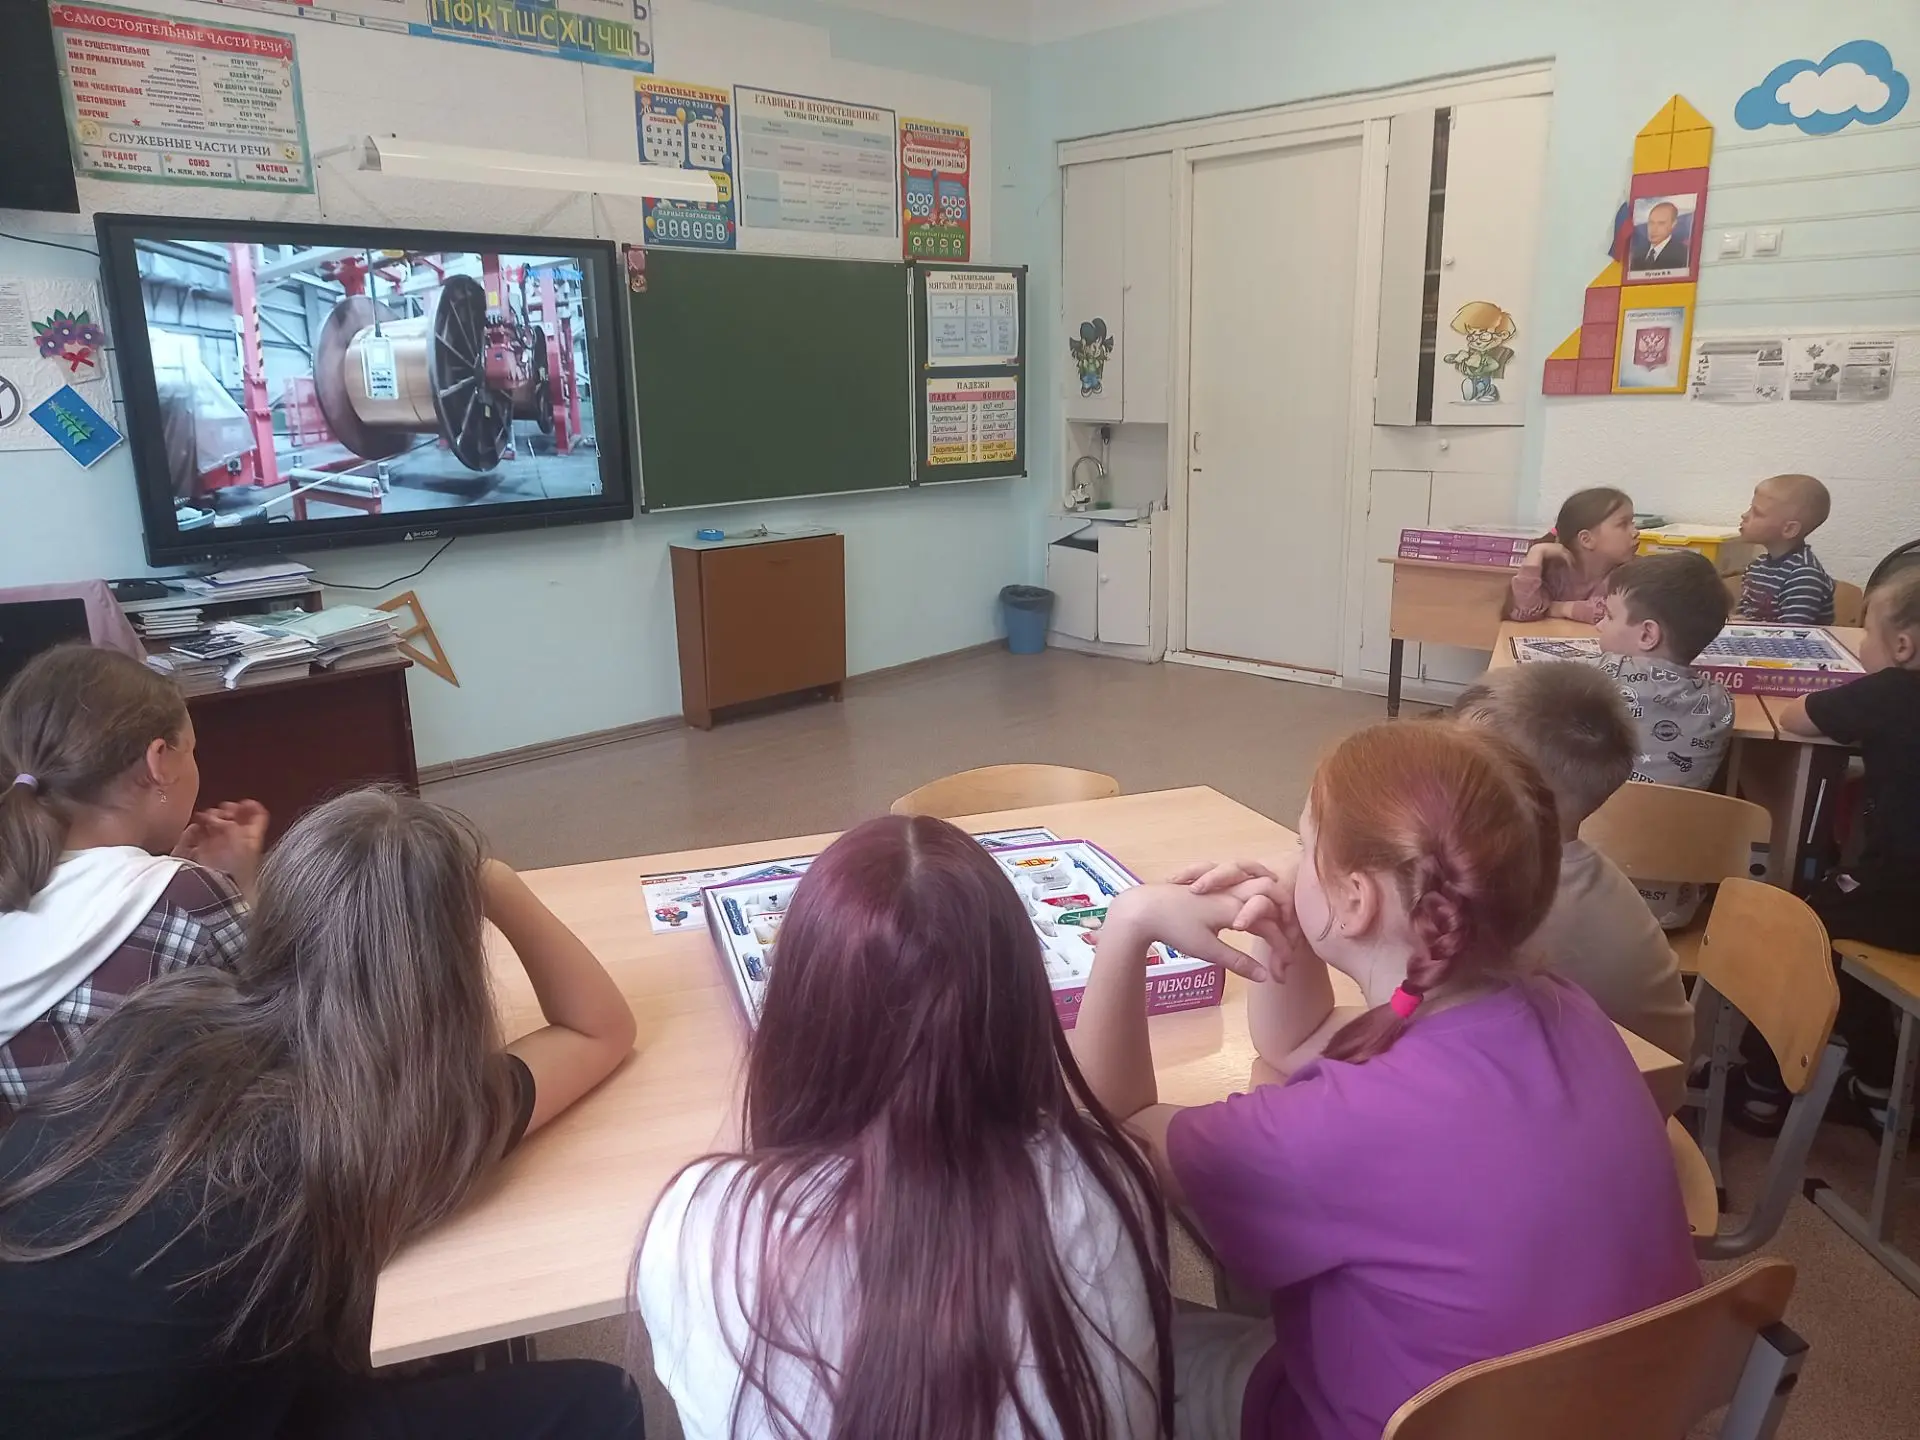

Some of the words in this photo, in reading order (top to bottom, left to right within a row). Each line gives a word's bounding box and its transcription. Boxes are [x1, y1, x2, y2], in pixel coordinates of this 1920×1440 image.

[63, 11, 205, 41] САМОСТОЯТЕЛЬНЫЕ
[206, 32, 250, 48] ЧАСТИ
[252, 40, 283, 53] РЕЧИ
[84, 39, 150, 56] СУЩЕСТВИТЕЛЬНОЕ
[86, 53, 146, 68] ПРИЛАГАТЕЛЬНОЕ
[640, 83, 696, 98] СОГЛАСНЫЕ
[699, 92, 727, 103] ЗВУКИ
[655, 96, 690, 106] РУССКОГО
[692, 101, 713, 110] ЯЗЫКА
[754, 94, 797, 109] ГЛАВНЫЕ
[799, 101, 805, 110] И
[807, 102, 880, 121] ВТОРОСТЕПЕННЫЕ
[784, 110, 807, 120] ЧЛЕНЫ
[808, 113, 854, 126] ПРЕДЛОЖЕНИЯ
[905, 122, 940, 134] ГЛАСНЫЕ
[108, 132, 192, 150] СЛУЖЕБНЫЕ
[195, 140, 237, 153] ЧАСТИ
[240, 144, 271, 157] РЕЧИ
[102, 150, 137, 161] ПРЕДЛОГ
[188, 158, 210, 168] СОЮЗ
[255, 163, 289, 174] ЧАСТИЦА
[929, 282, 957, 290] МЯГКИЙ
[957, 381, 990, 389] ПАДЕЖИ
[1690, 738, 1715, 750] BEST
[1157, 977, 1192, 994] СХЕМ
[1193, 971, 1216, 988] 979
